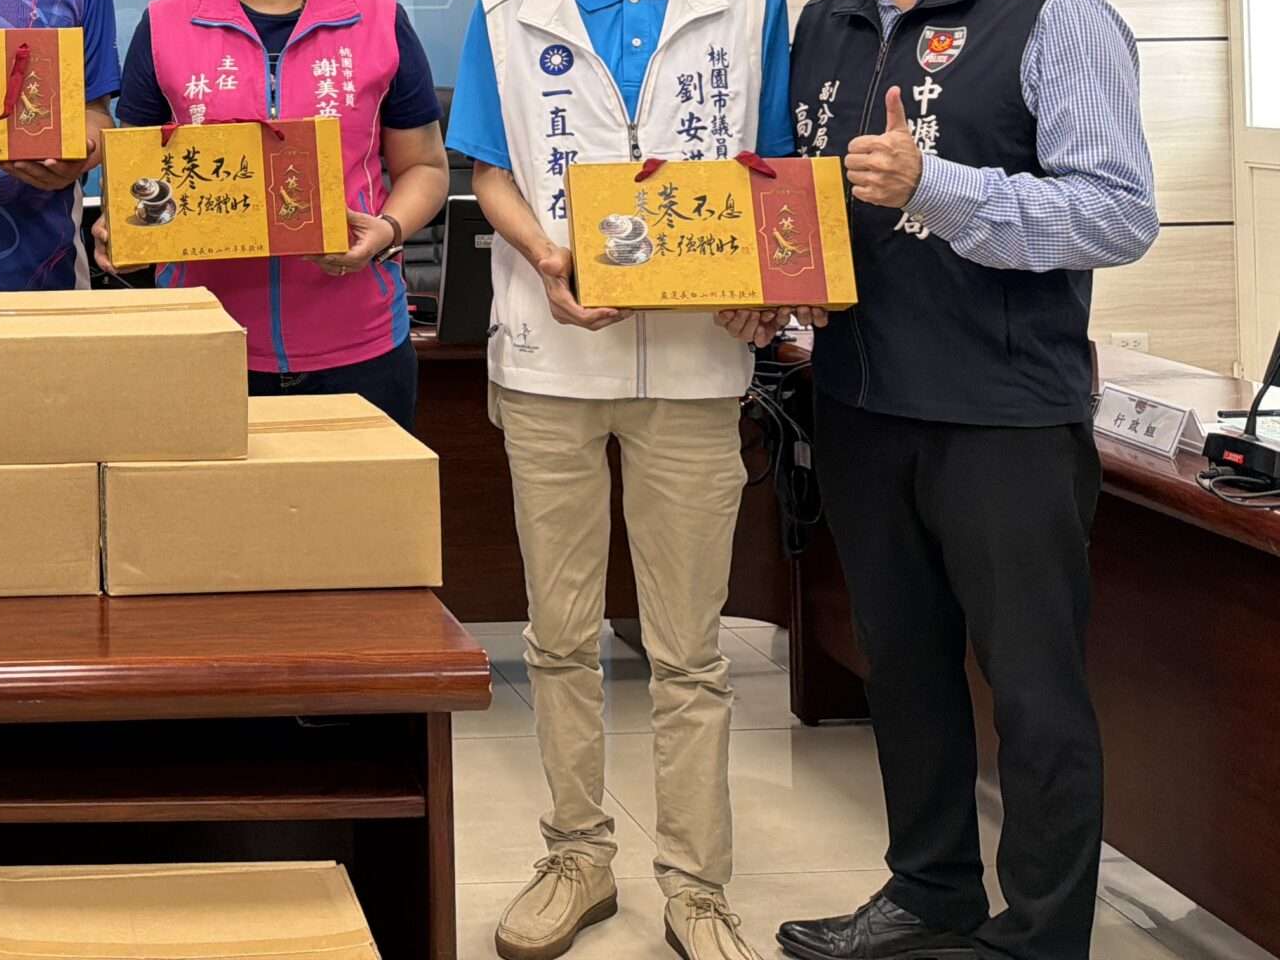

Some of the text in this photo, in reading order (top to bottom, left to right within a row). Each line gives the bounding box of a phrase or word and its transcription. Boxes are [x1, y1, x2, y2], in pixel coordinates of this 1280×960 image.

[215, 54, 240, 91] 主任
[708, 43, 733, 160] 桃園市議員
[812, 80, 840, 158] 副分局
[541, 89, 578, 221] 一直都在
[893, 76, 943, 240] 中壢局
